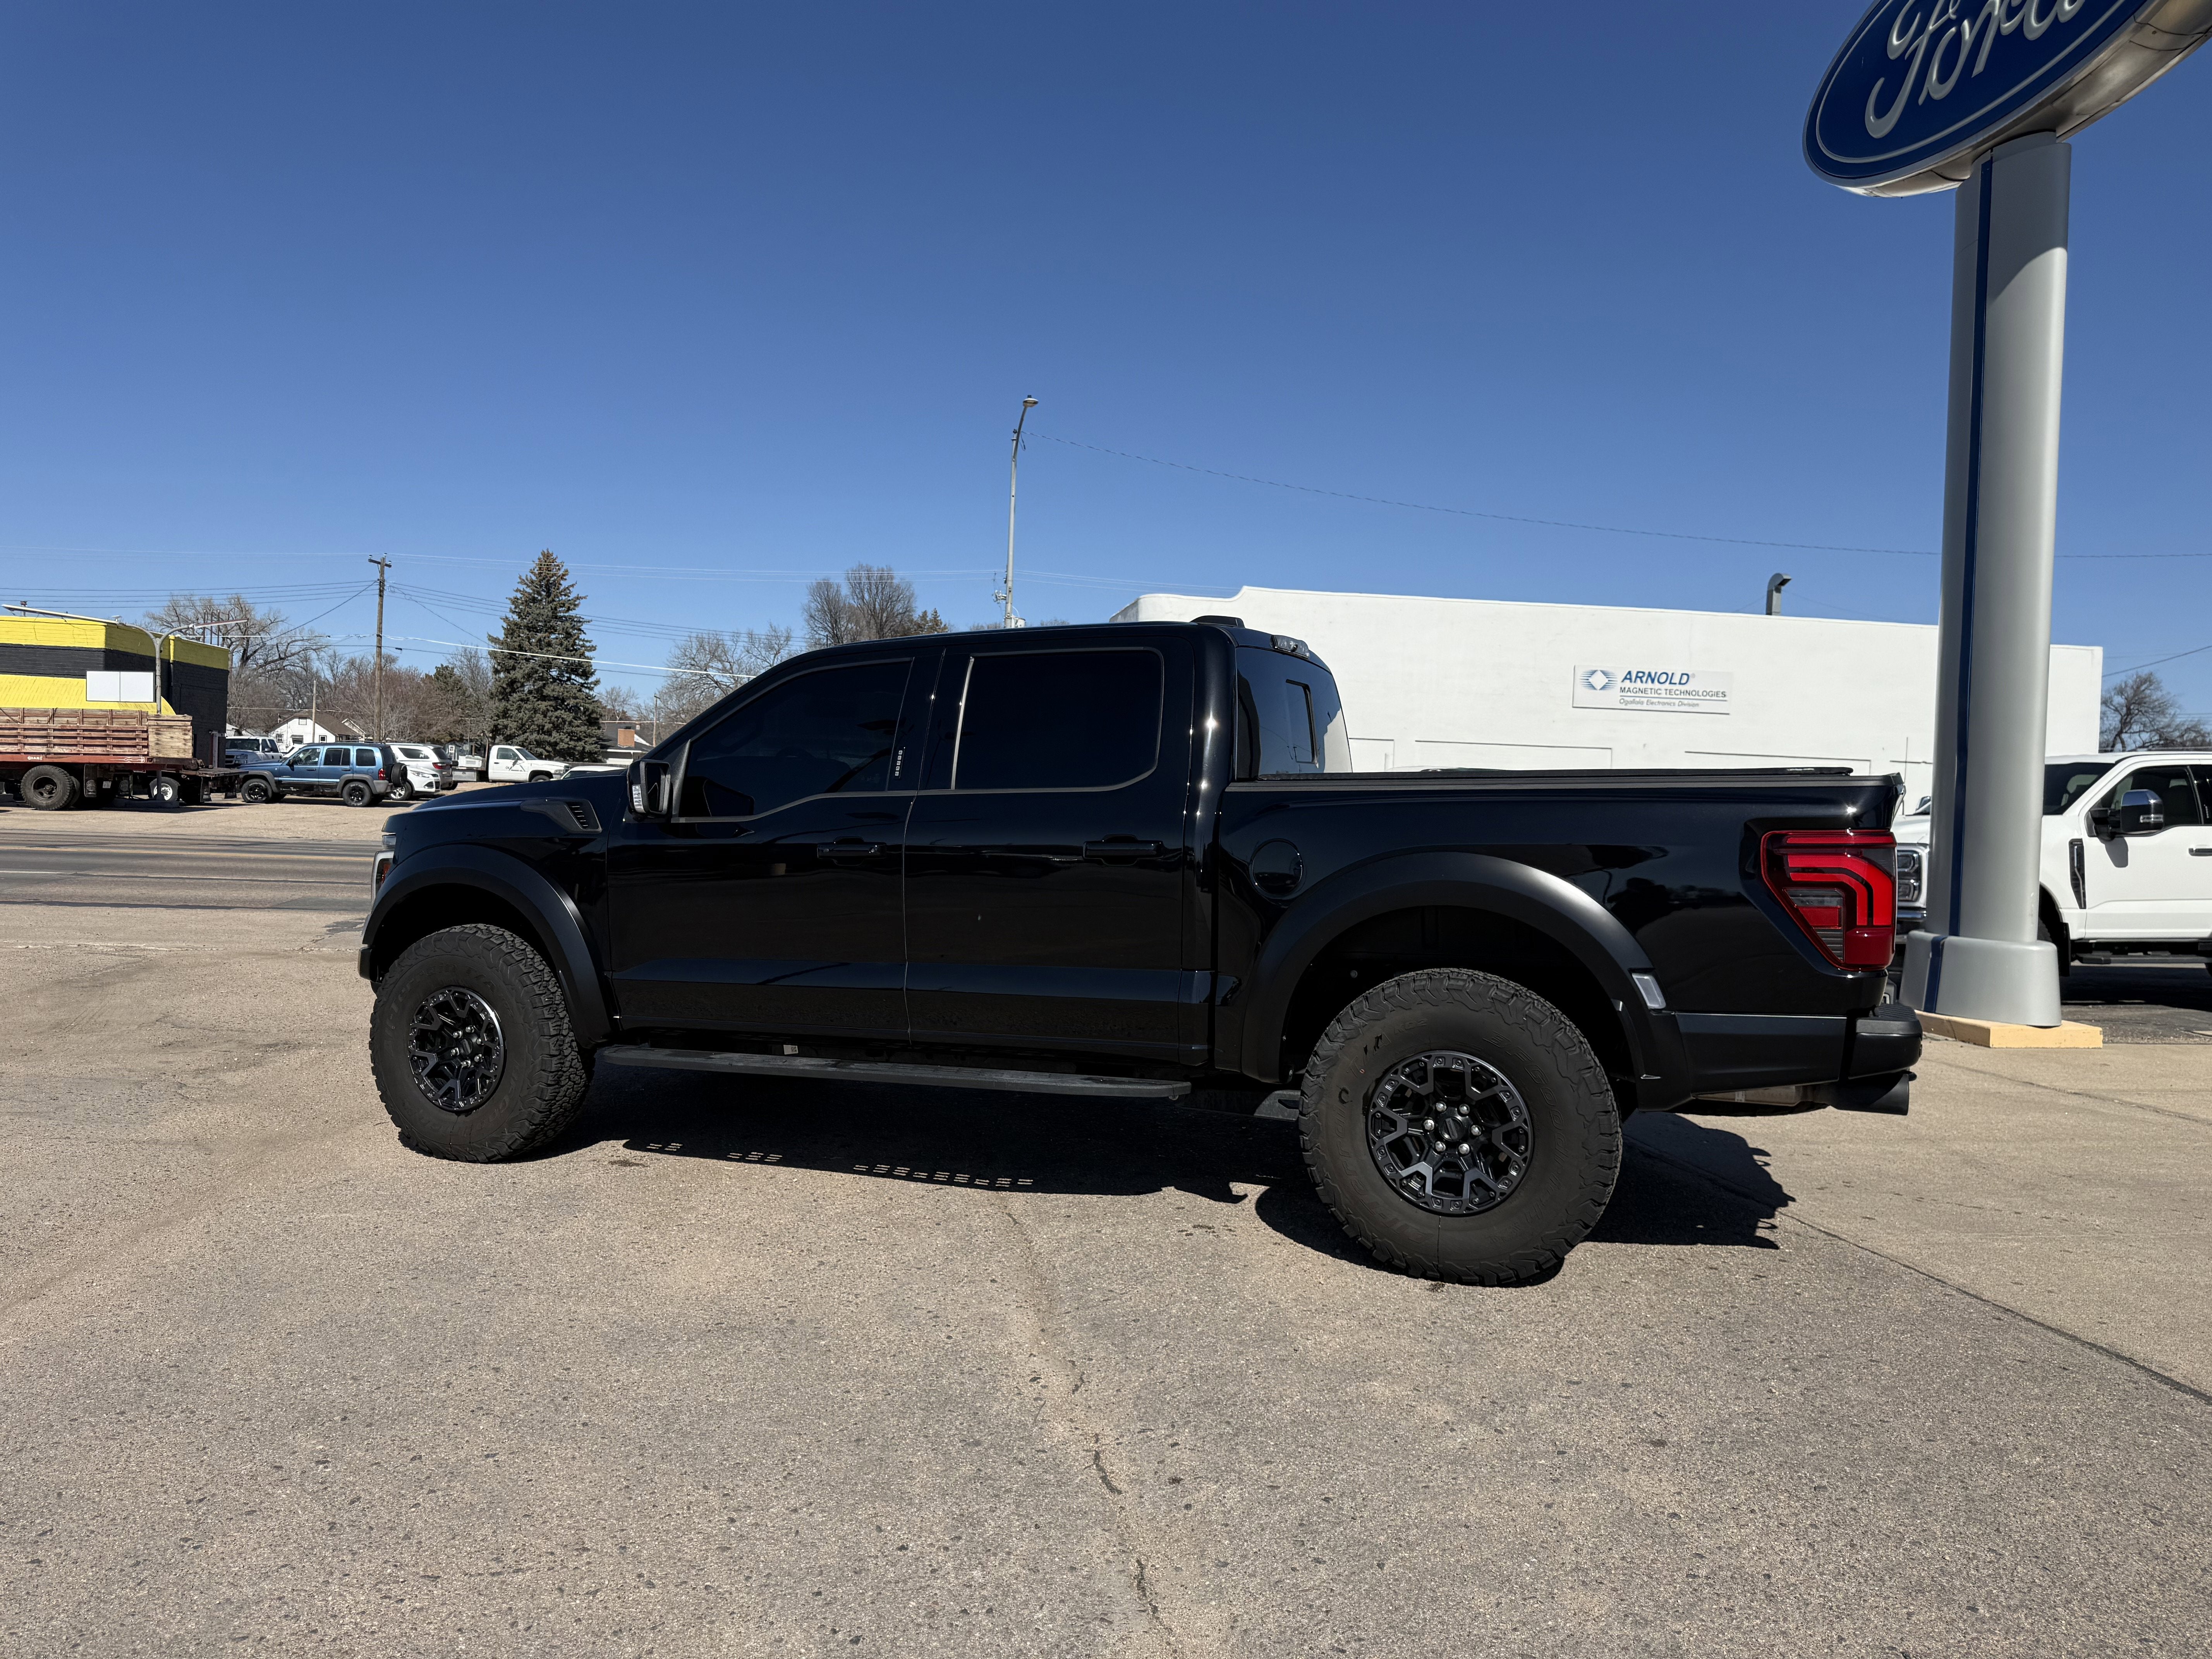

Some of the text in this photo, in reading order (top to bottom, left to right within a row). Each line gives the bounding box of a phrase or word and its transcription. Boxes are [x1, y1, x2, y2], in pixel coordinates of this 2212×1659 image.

[1620, 687, 1726, 698] MAGNETIC TECHNOLOGIES
[1619, 698, 1644, 706] Ogallala
